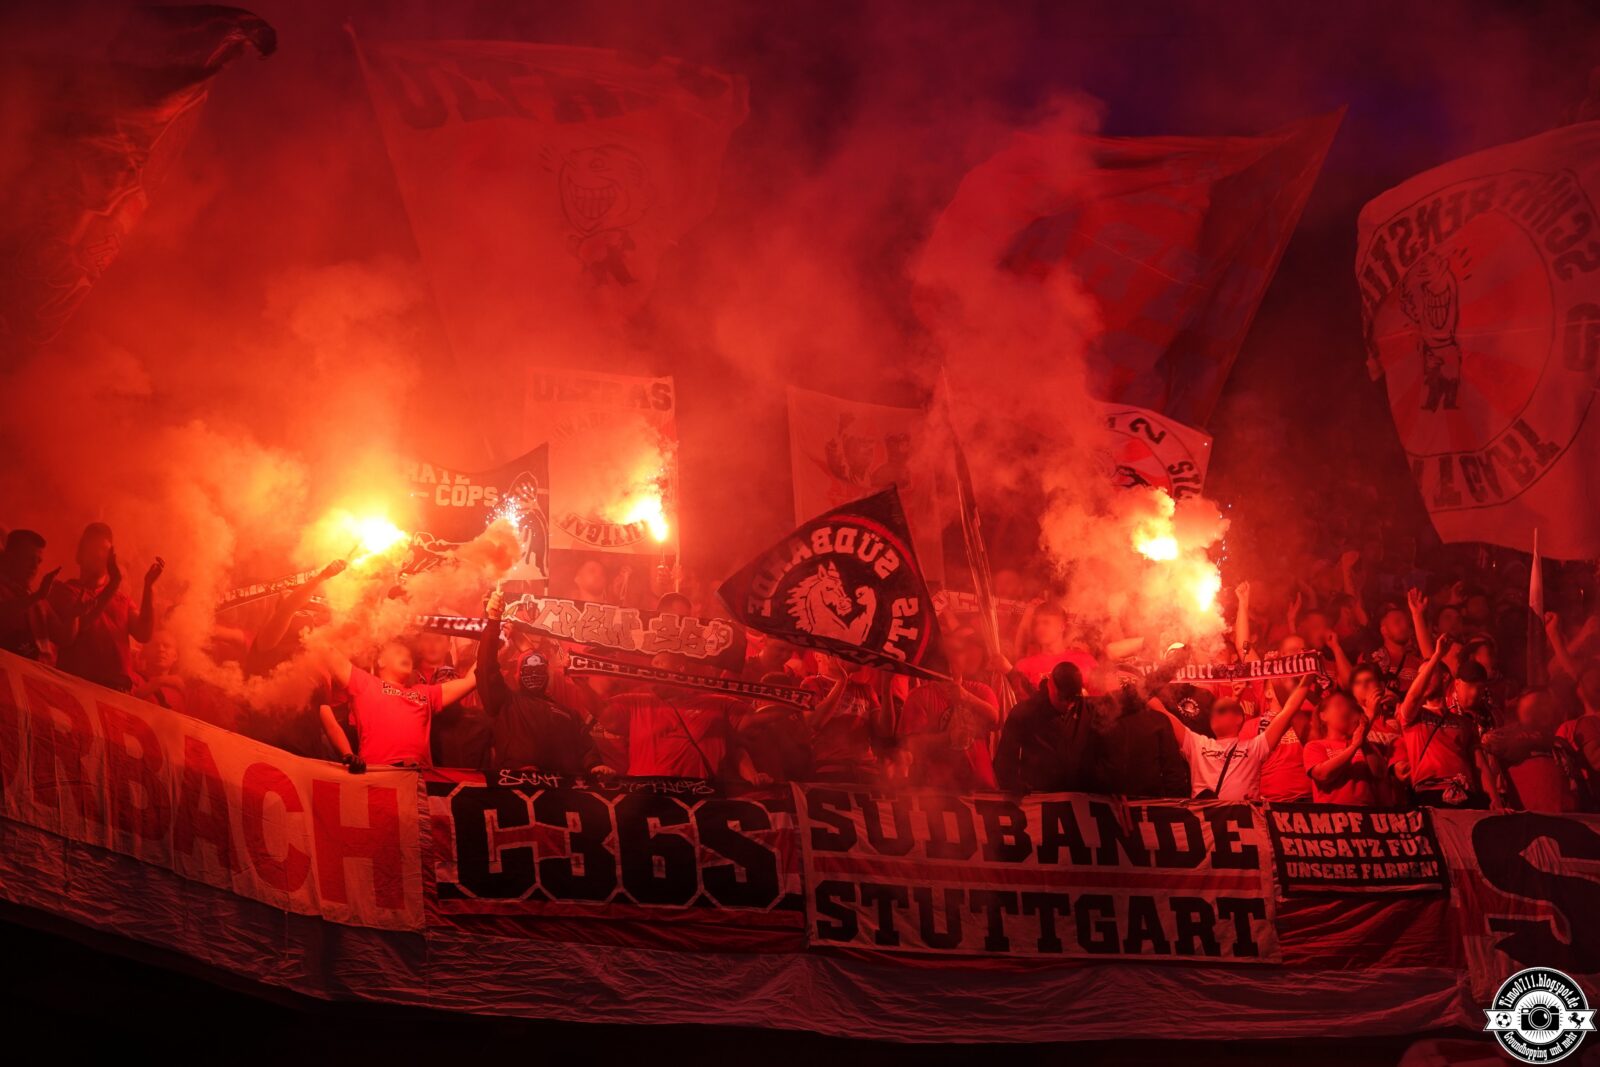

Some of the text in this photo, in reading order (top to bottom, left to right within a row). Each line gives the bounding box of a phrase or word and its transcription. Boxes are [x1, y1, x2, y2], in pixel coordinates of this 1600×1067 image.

[435, 484, 499, 507] COPS
[532, 598, 641, 651] CREW
[1272, 811, 1424, 835] KAMPF UND
[452, 785, 781, 910] C36S
[1280, 833, 1434, 858] EINSATZ FÜR
[1285, 861, 1439, 879] UNSERE FARBEN!
[815, 880, 1267, 957] STUTTGART
